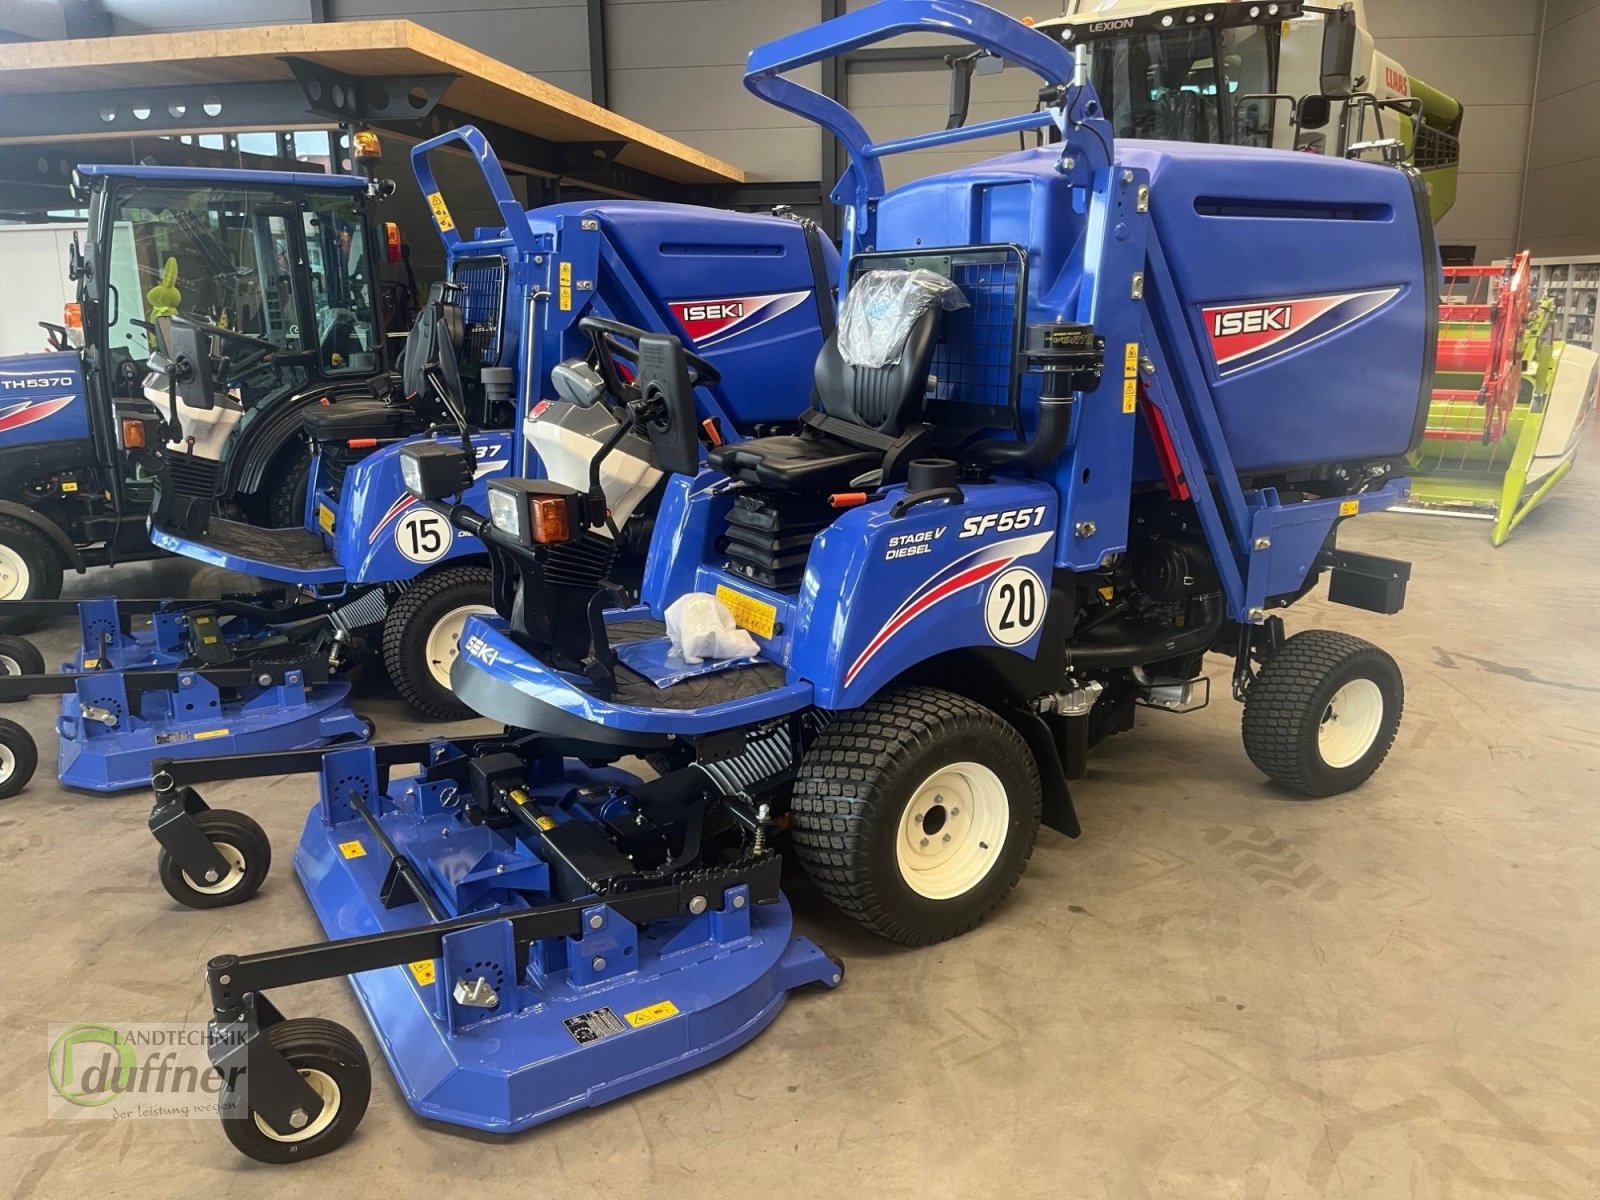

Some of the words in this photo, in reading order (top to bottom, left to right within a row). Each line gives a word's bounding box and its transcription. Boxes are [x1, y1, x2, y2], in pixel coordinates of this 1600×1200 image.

[1089, 18, 1134, 33] LEXION
[1385, 66, 1408, 97] CLAAS
[683, 302, 744, 321] ISEKI
[1214, 305, 1292, 337] ISEKI
[1, 376, 73, 390] TH5370
[959, 505, 1047, 539] SF551
[405, 518, 441, 555] 15
[888, 530, 934, 548] STAGE
[934, 525, 949, 540] V
[884, 543, 932, 560] DIESEL
[998, 578, 1035, 630] 20
